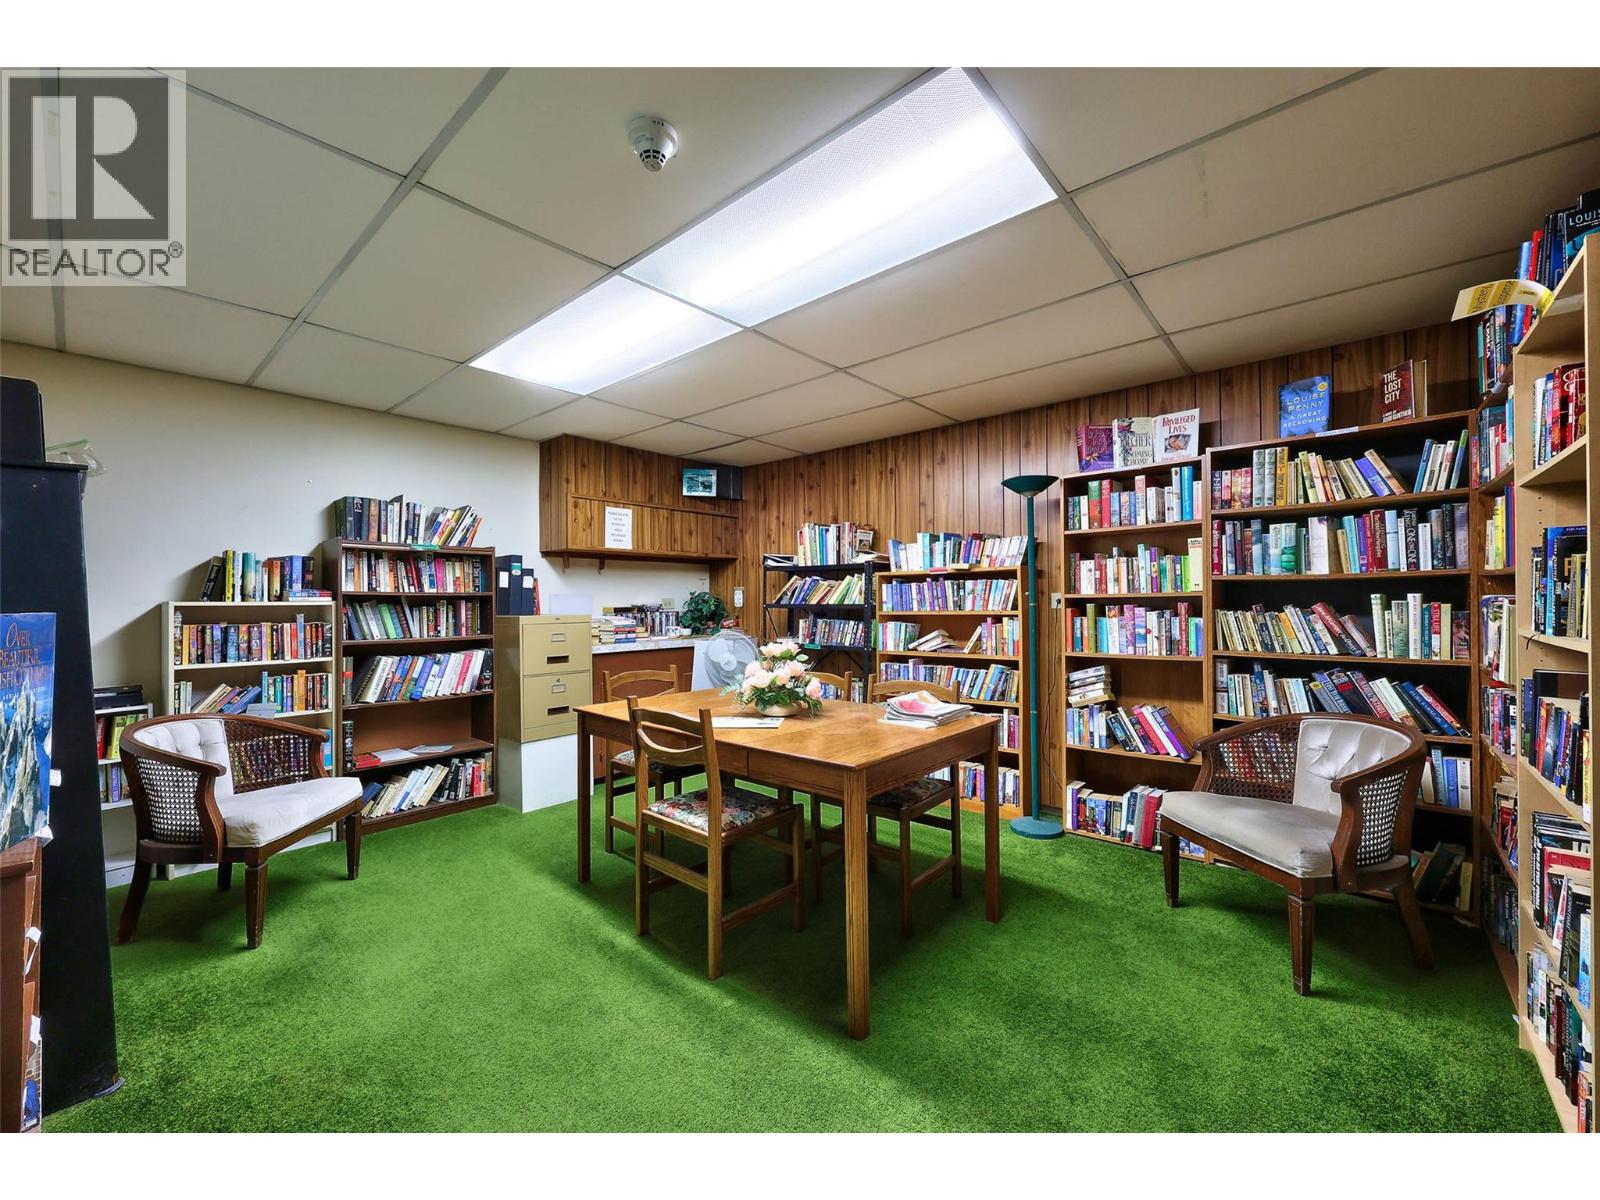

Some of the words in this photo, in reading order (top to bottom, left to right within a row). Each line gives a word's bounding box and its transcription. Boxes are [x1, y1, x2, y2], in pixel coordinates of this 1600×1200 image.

[1383, 370, 1398, 384] THE
[1384, 378, 1402, 394] LOST
[1286, 391, 1326, 406] LOUISE
[1384, 390, 1401, 404] CITY
[1287, 400, 1324, 413] PENNY
[1162, 414, 1196, 427] PRIVILEGED
[1283, 415, 1328, 428] RECKONING
[1297, 410, 1322, 420] GREAT
[1168, 425, 1188, 435] LIVES
[1407, 527, 1416, 542] ONE
[1407, 549, 1417, 564] ONE
[1432, 608, 1440, 621] STILL
